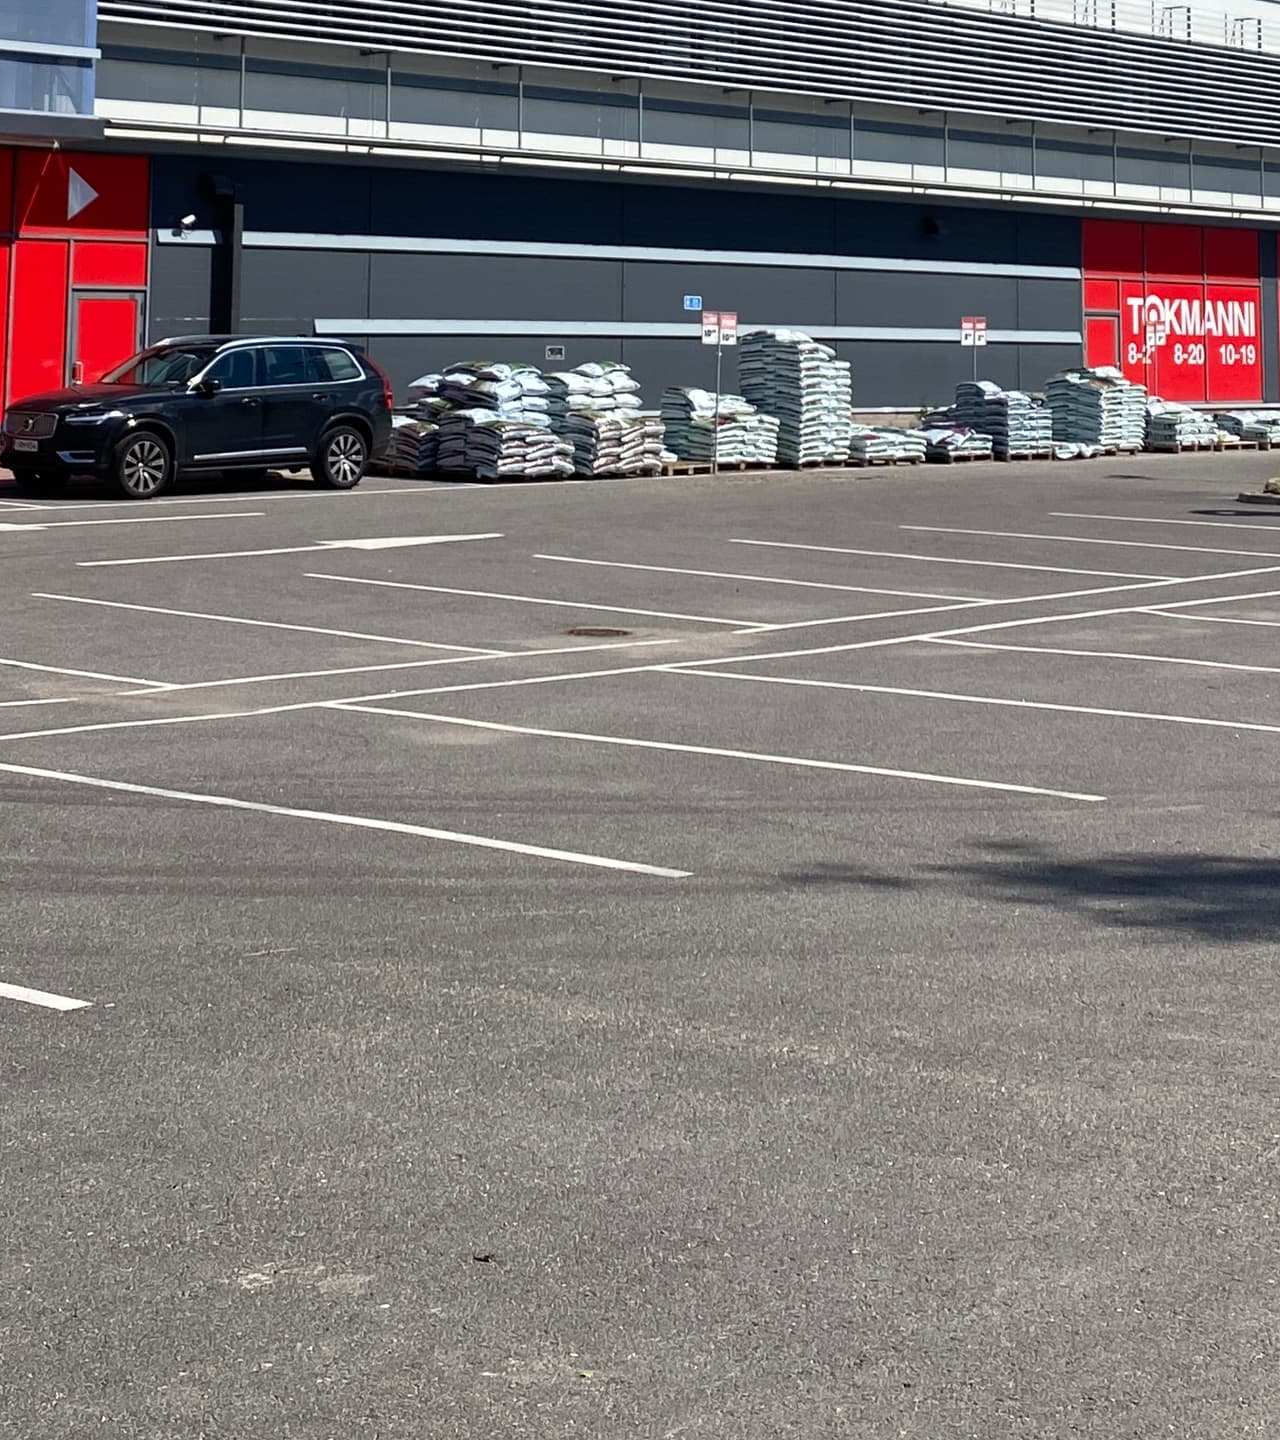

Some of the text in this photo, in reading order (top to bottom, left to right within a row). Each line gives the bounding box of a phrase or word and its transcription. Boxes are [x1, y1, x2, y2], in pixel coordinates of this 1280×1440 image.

[1126, 294, 1257, 337] TOKMANNI
[1127, 342, 1257, 365] 8-2 8-20 10-19
